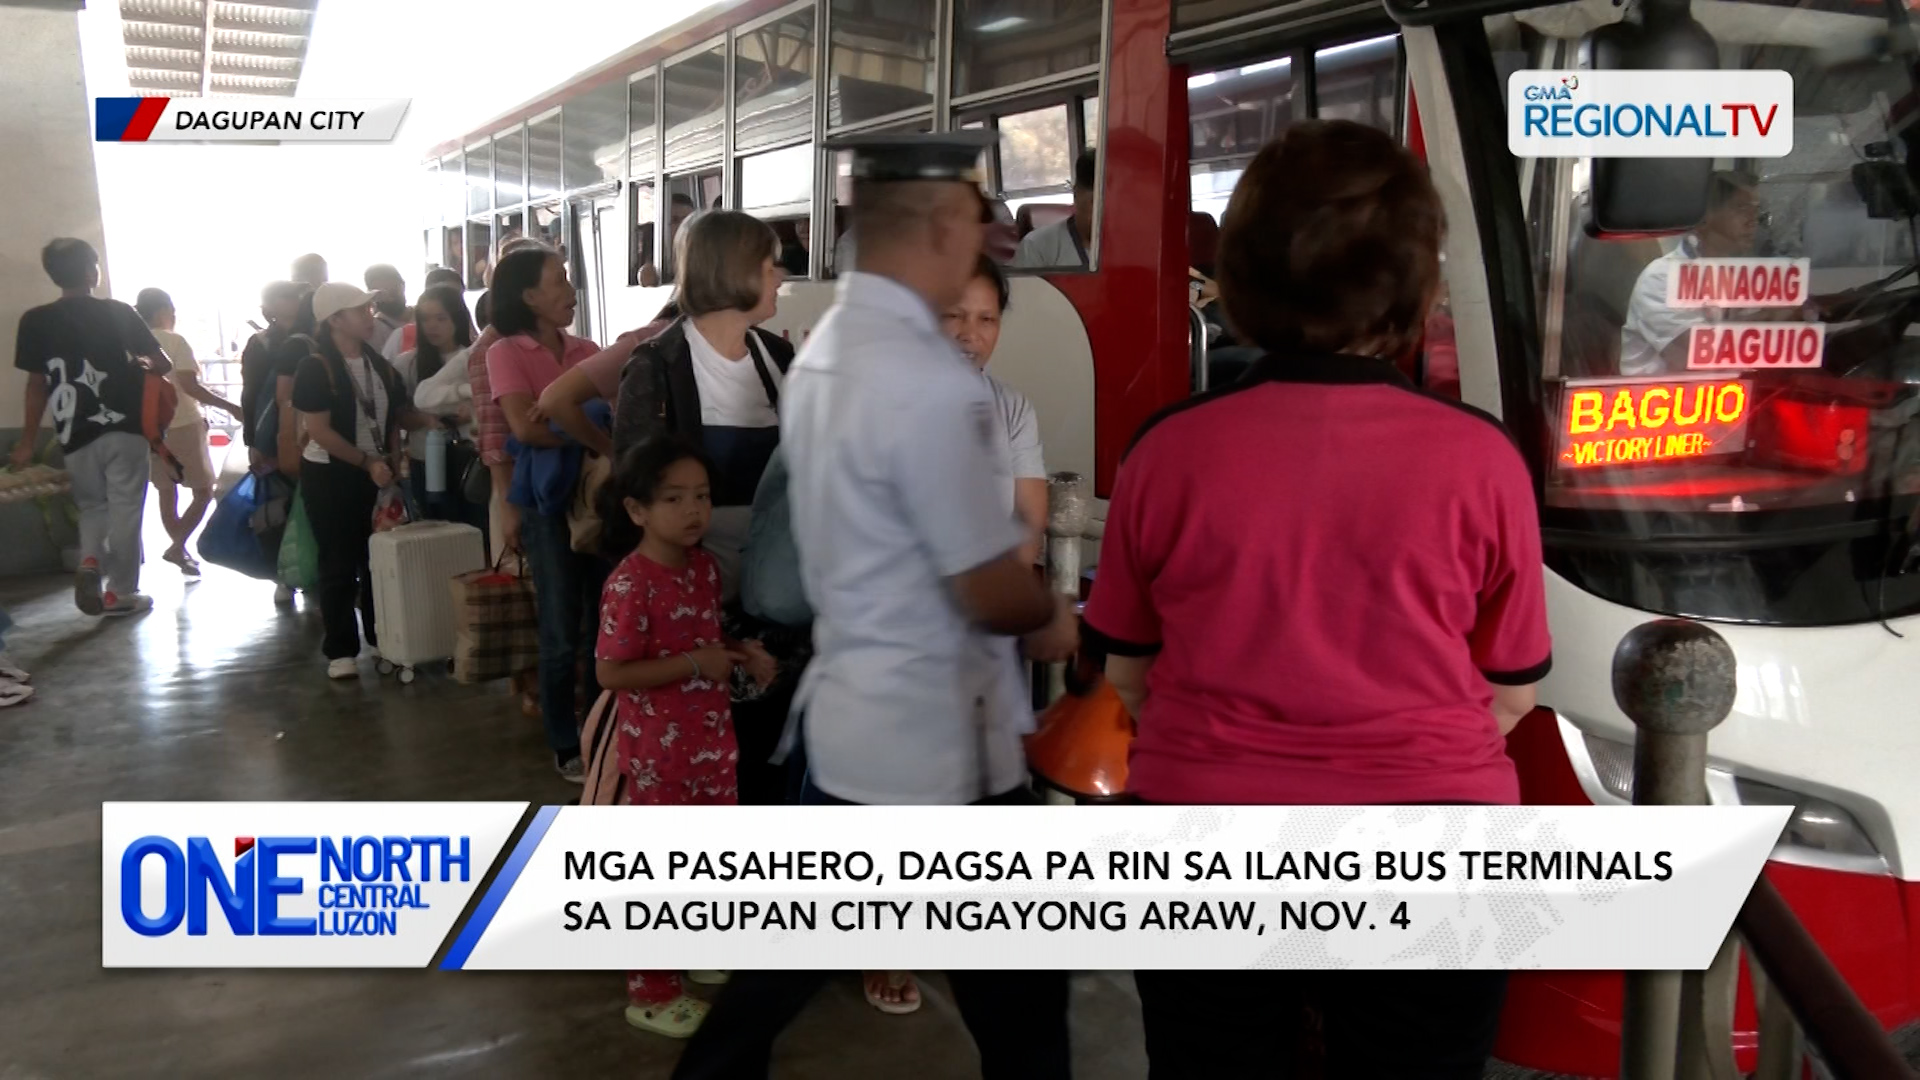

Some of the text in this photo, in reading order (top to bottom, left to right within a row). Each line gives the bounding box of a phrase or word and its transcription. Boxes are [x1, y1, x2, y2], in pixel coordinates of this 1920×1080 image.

[1677, 263, 1801, 301] MANAOAG
[1692, 328, 1819, 365] BAGUIO
[1569, 383, 1745, 434] BAGUIO
